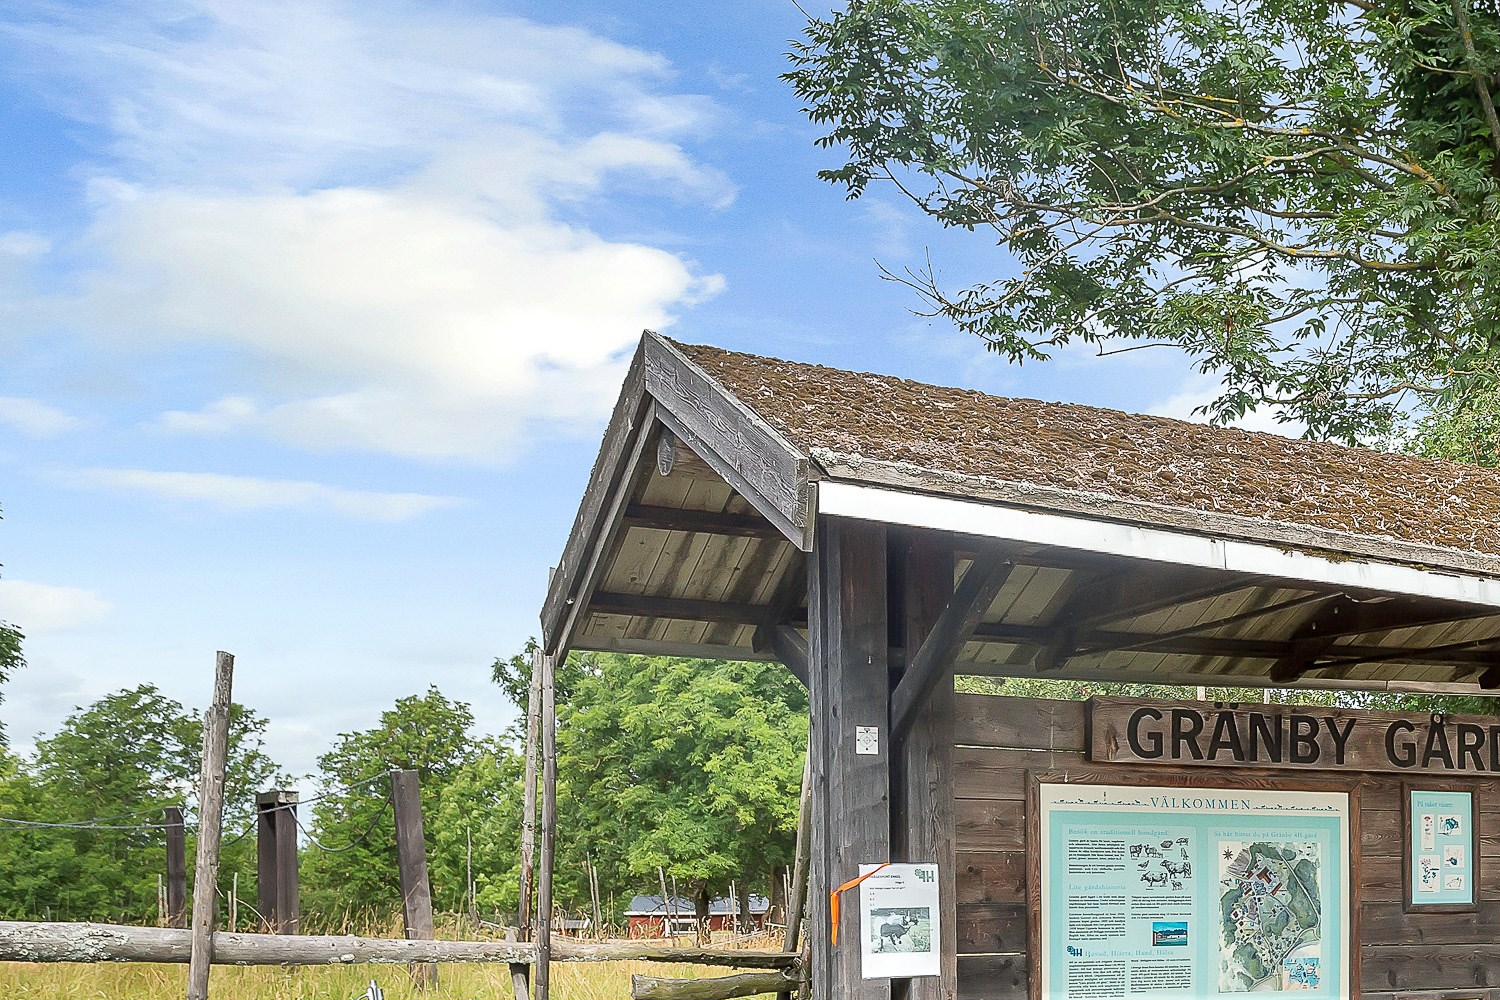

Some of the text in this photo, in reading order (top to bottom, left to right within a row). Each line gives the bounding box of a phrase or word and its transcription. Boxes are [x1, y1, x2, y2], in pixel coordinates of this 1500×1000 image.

[1126, 702, 1358, 765] GRÄNBY
[1150, 795, 1252, 811] VÄLKOMMEN
[1069, 947, 1083, 957] 4H
